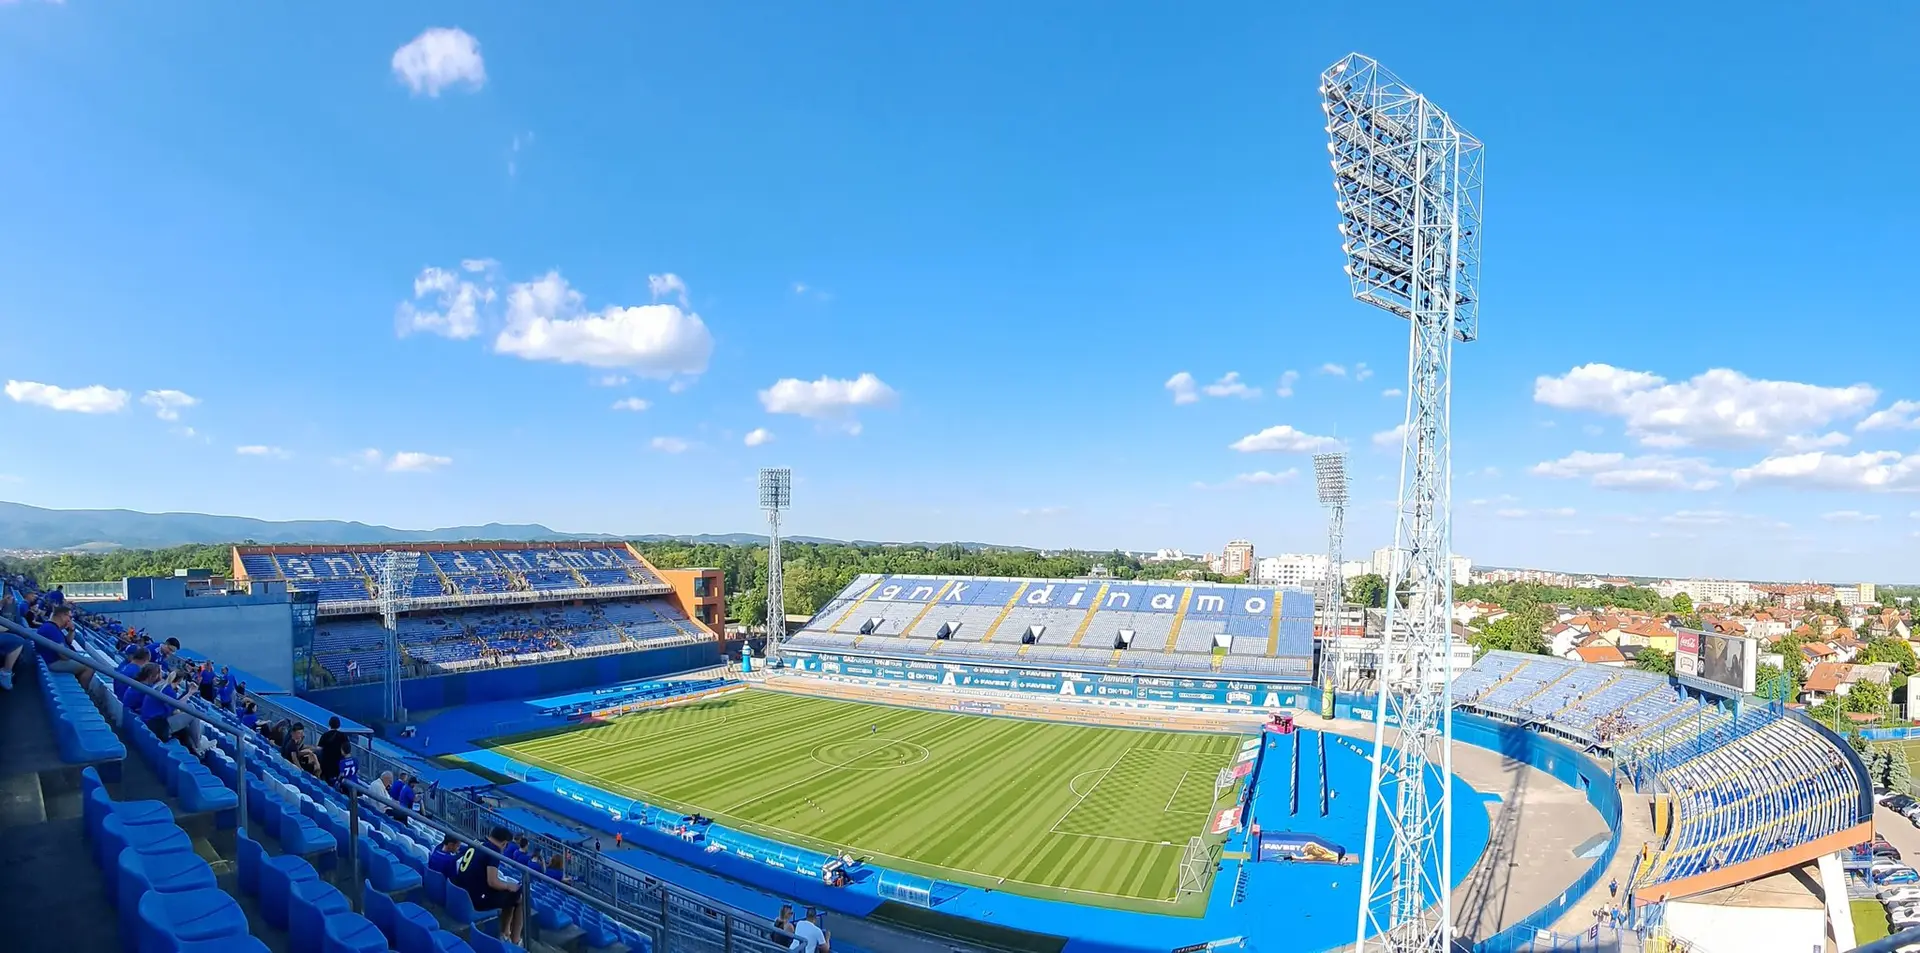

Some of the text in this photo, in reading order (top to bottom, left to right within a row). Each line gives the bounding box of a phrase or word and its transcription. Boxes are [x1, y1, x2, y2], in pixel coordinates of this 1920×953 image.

[453, 551, 612, 571] dinamo
[878, 581, 1266, 613] gnk dinamo
[980, 667, 1009, 675] FAVBET
[980, 679, 1010, 687] FAVBET
[1227, 681, 1257, 690] Agram
[1264, 843, 1301, 851] FAVBET
[460, 848, 475, 872] 9
